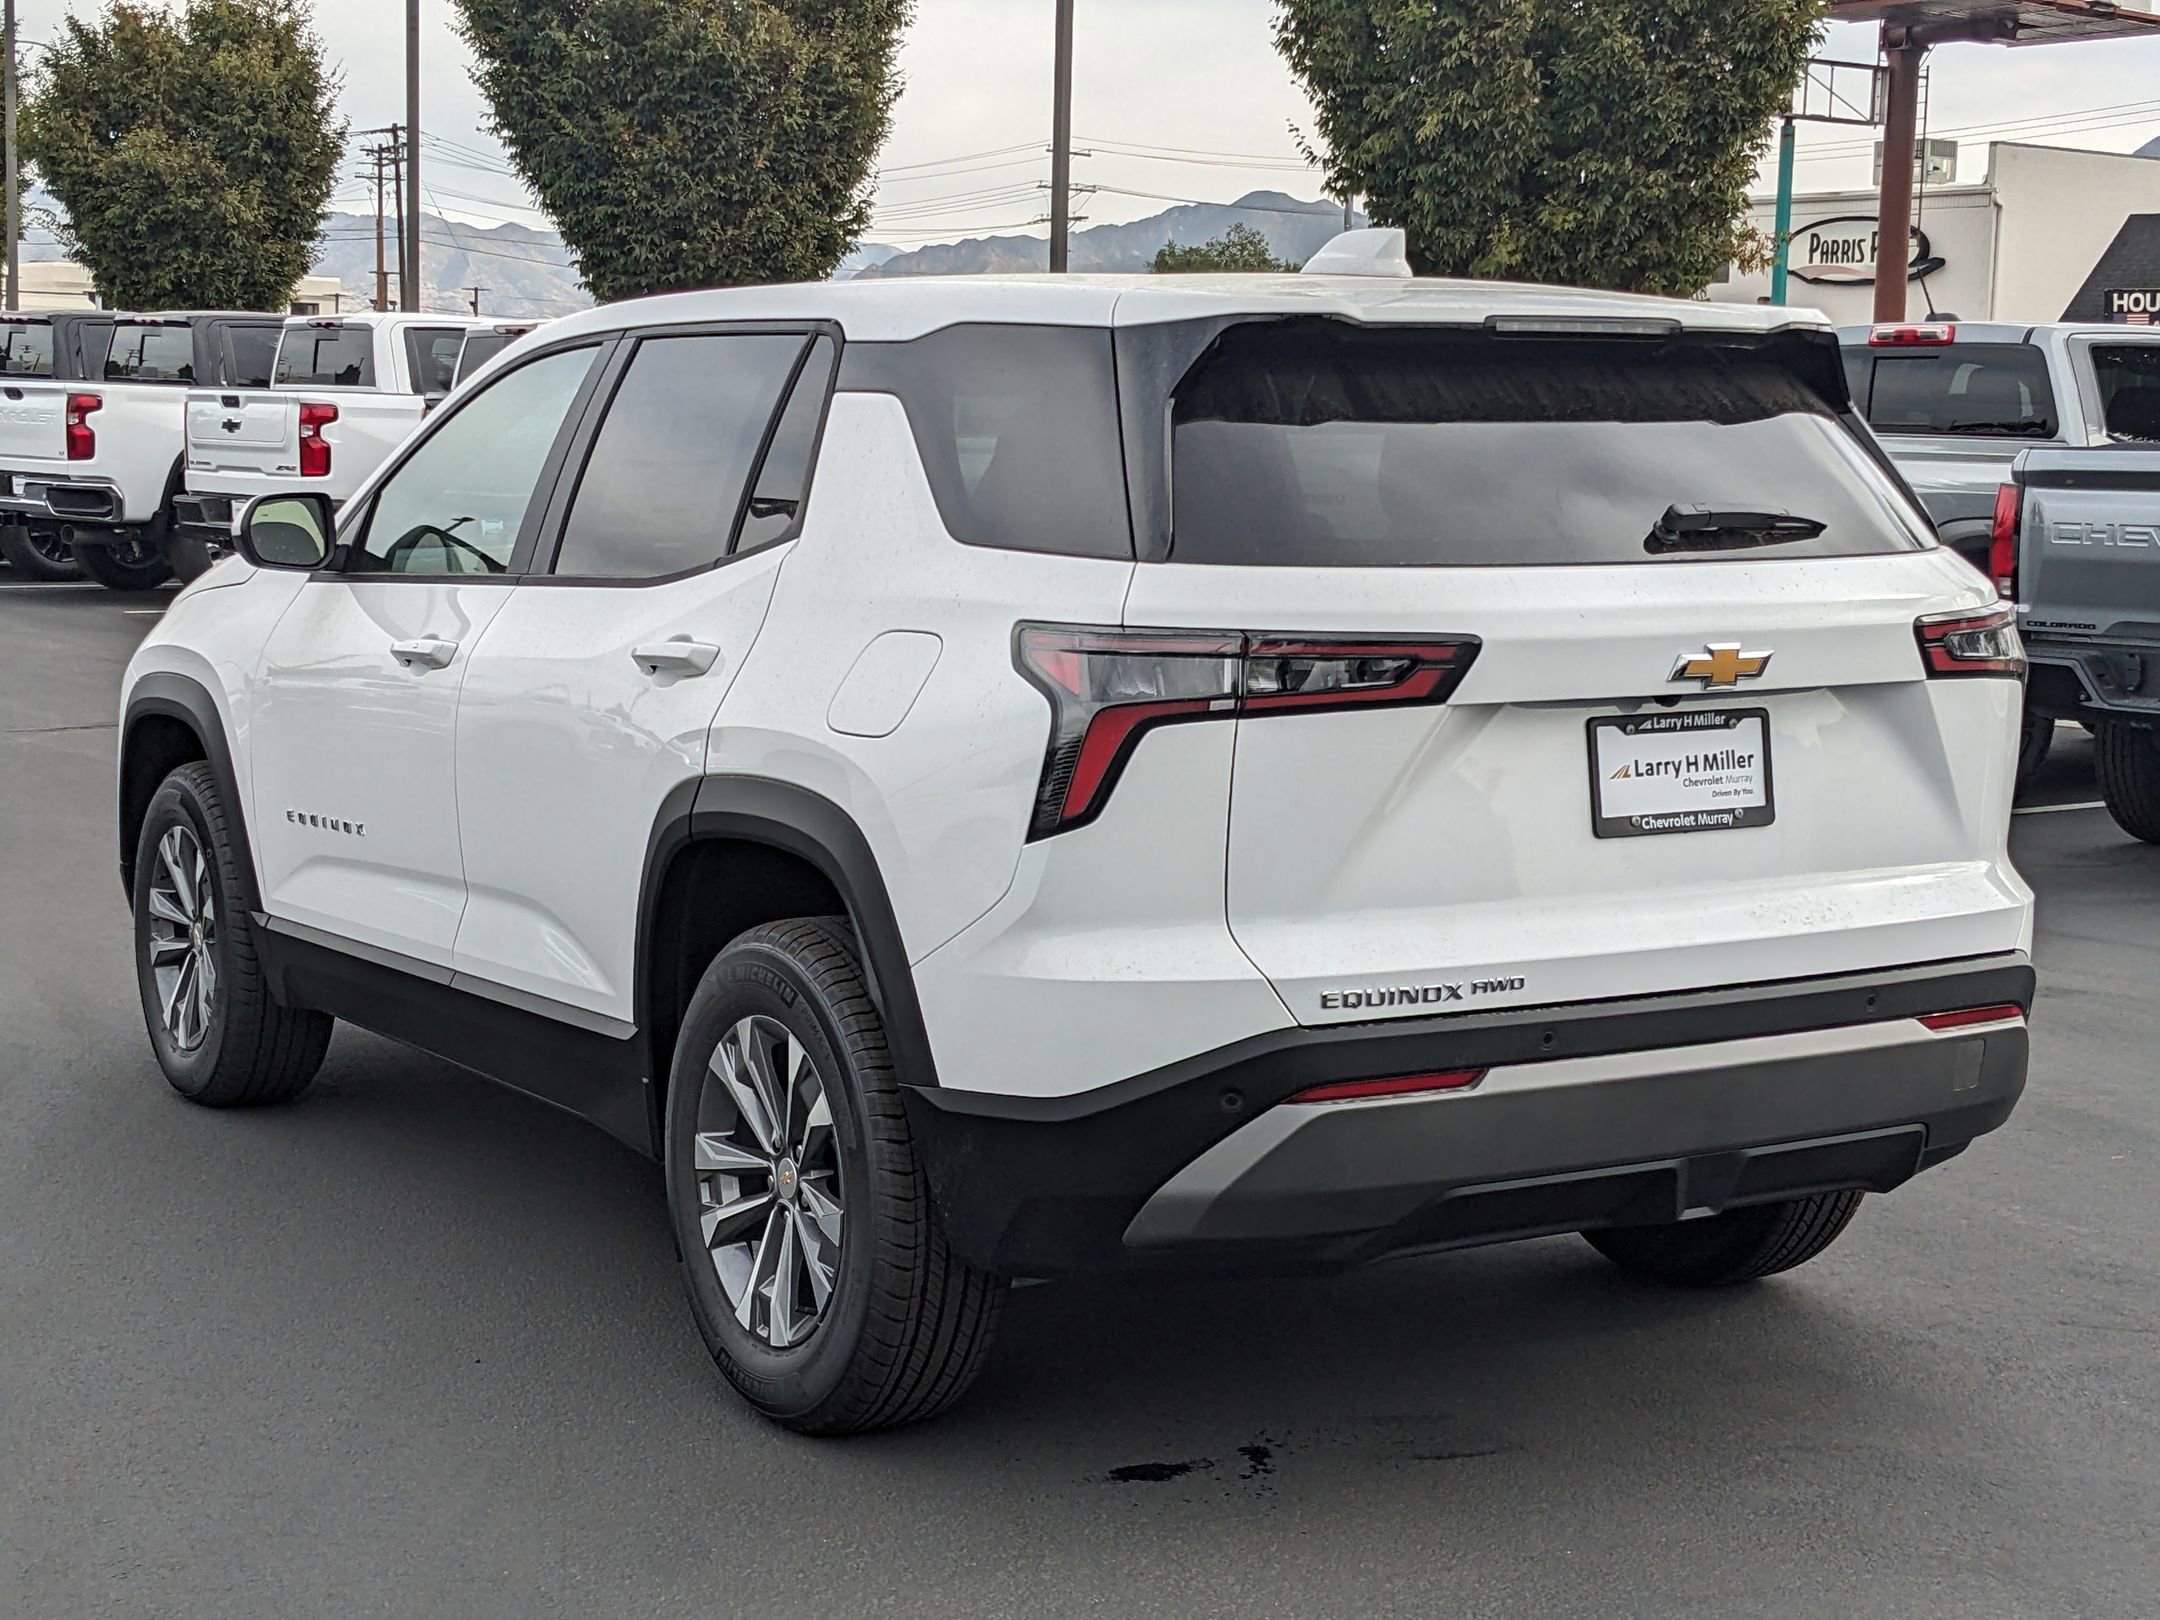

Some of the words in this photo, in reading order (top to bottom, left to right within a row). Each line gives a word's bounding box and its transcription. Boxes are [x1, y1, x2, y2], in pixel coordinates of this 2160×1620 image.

[1808, 232, 1866, 264] PARRIS
[2112, 292, 2160, 313] HOU
[2026, 620, 2096, 630] COLORADO
[1653, 716, 1682, 730] Larry
[1683, 715, 1693, 727] H
[1693, 711, 1726, 726] Miller
[1634, 759, 1682, 779] Larry
[1685, 754, 1699, 773] H
[1703, 749, 1754, 772] Miller
[1682, 775, 1724, 788] Chevrolet
[1725, 774, 1753, 785] Murray
[1711, 789, 1732, 798] Driven
[1733, 788, 1741, 797] By
[286, 810, 366, 836] EQUINOX
[1641, 813, 1696, 830] Chevrolet
[1697, 812, 1733, 827] Murray
[1320, 981, 1464, 1010] EQUINOX
[1470, 975, 1526, 995] AWD
